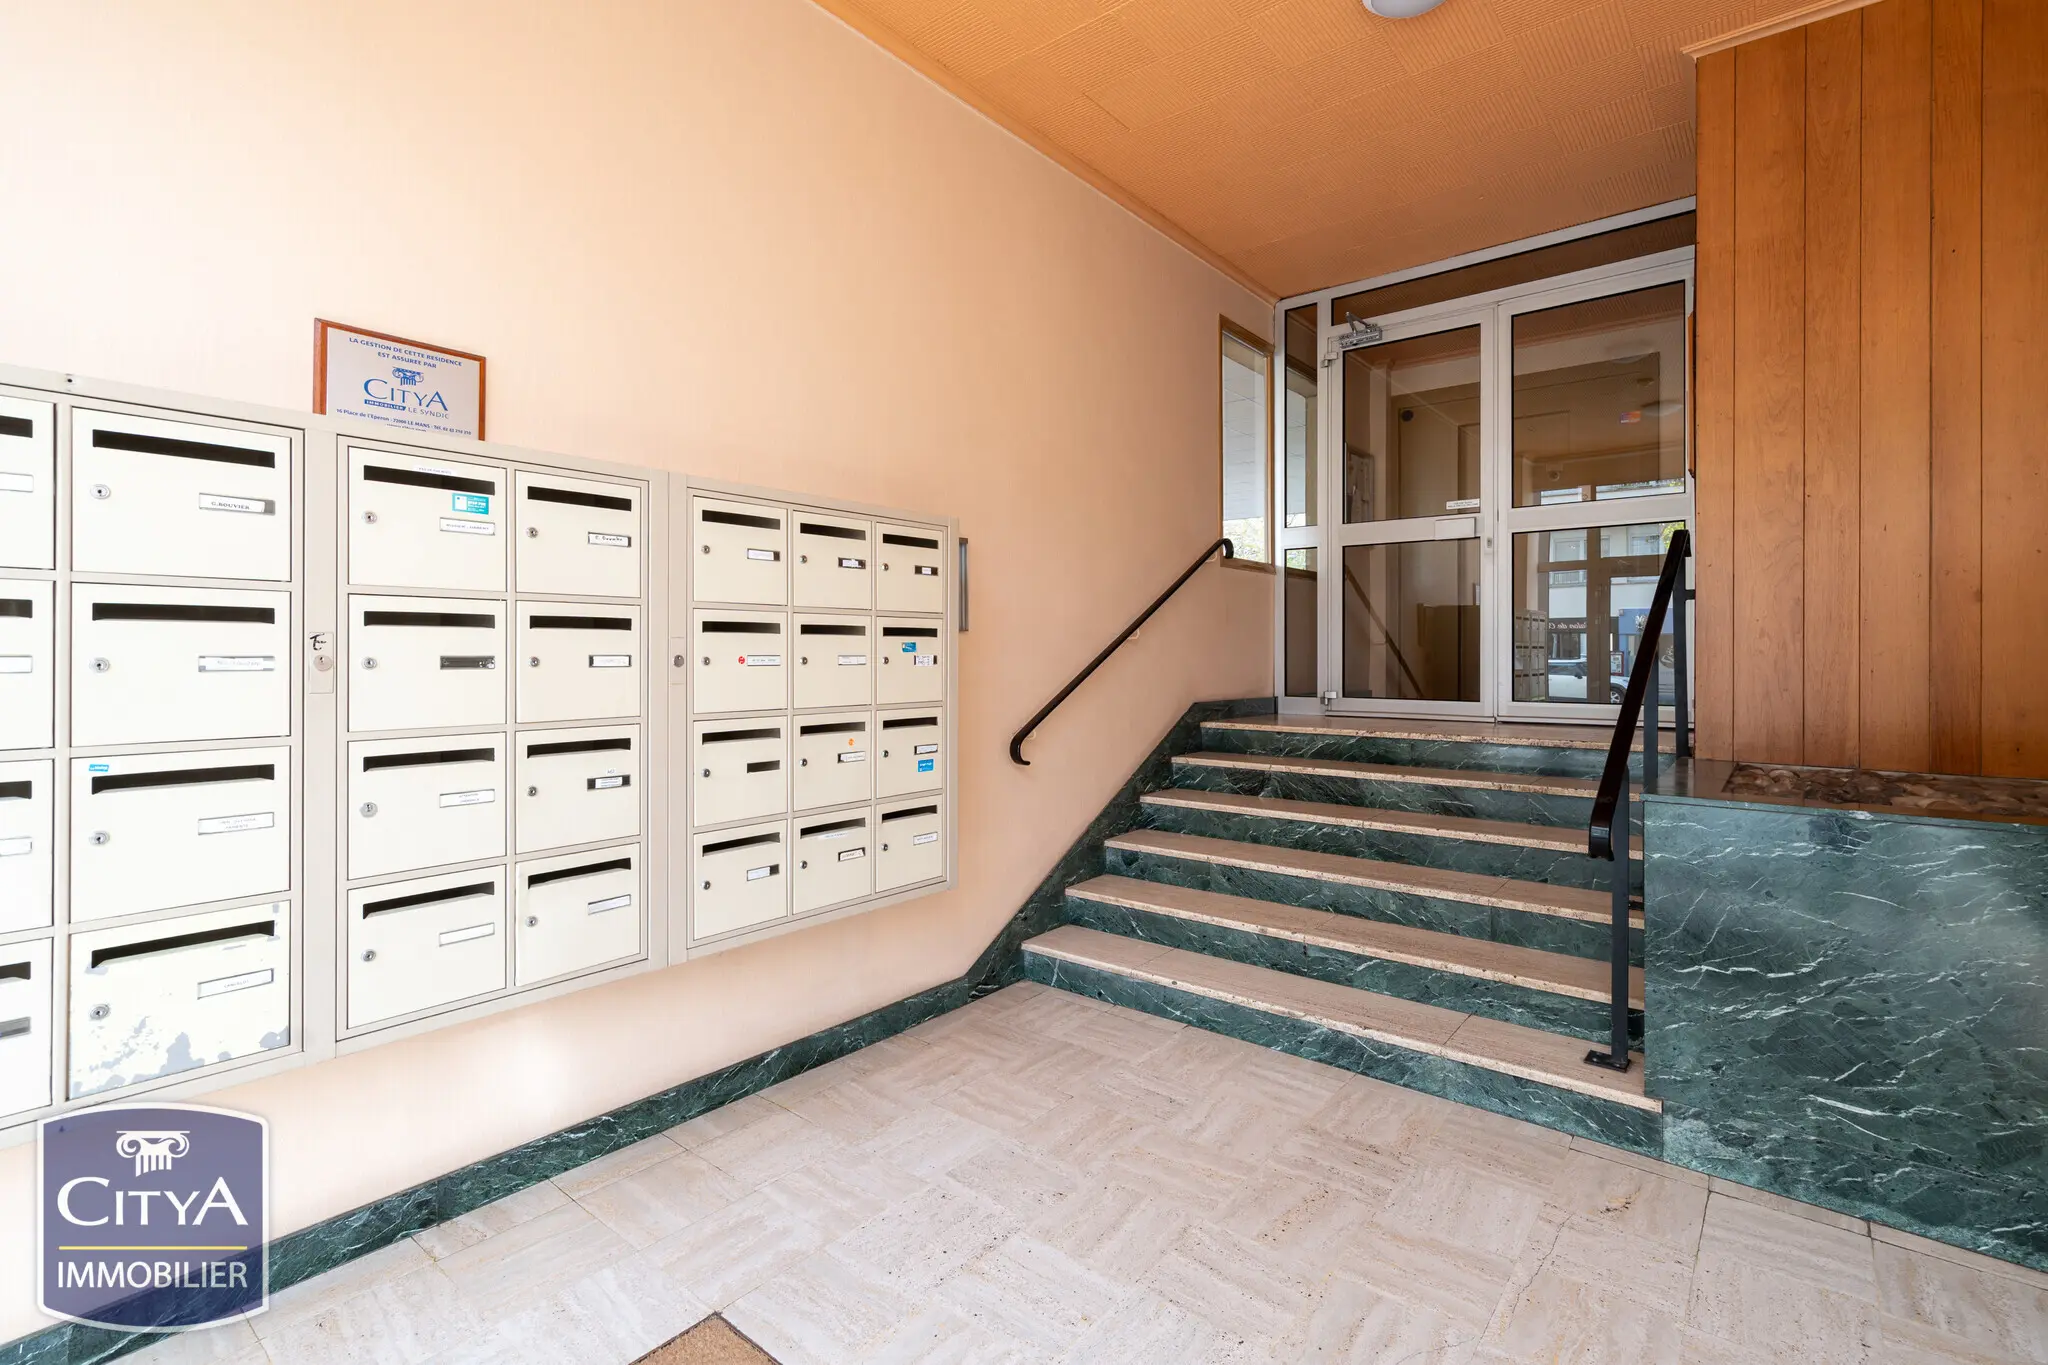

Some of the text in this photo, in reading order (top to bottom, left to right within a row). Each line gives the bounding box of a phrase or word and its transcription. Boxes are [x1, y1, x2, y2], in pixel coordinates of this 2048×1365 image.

[360, 339, 391, 351] GESTION
[403, 349, 425, 359] CETTE
[426, 354, 462, 367] RESIDENCE
[377, 351, 437, 369] EST ASSUREE PAR
[363, 378, 449, 412] CITYA
[366, 400, 404, 410] IMMOBILIER
[420, 409, 449, 419] SYNDIC
[414, 421, 430, 429] MANS
